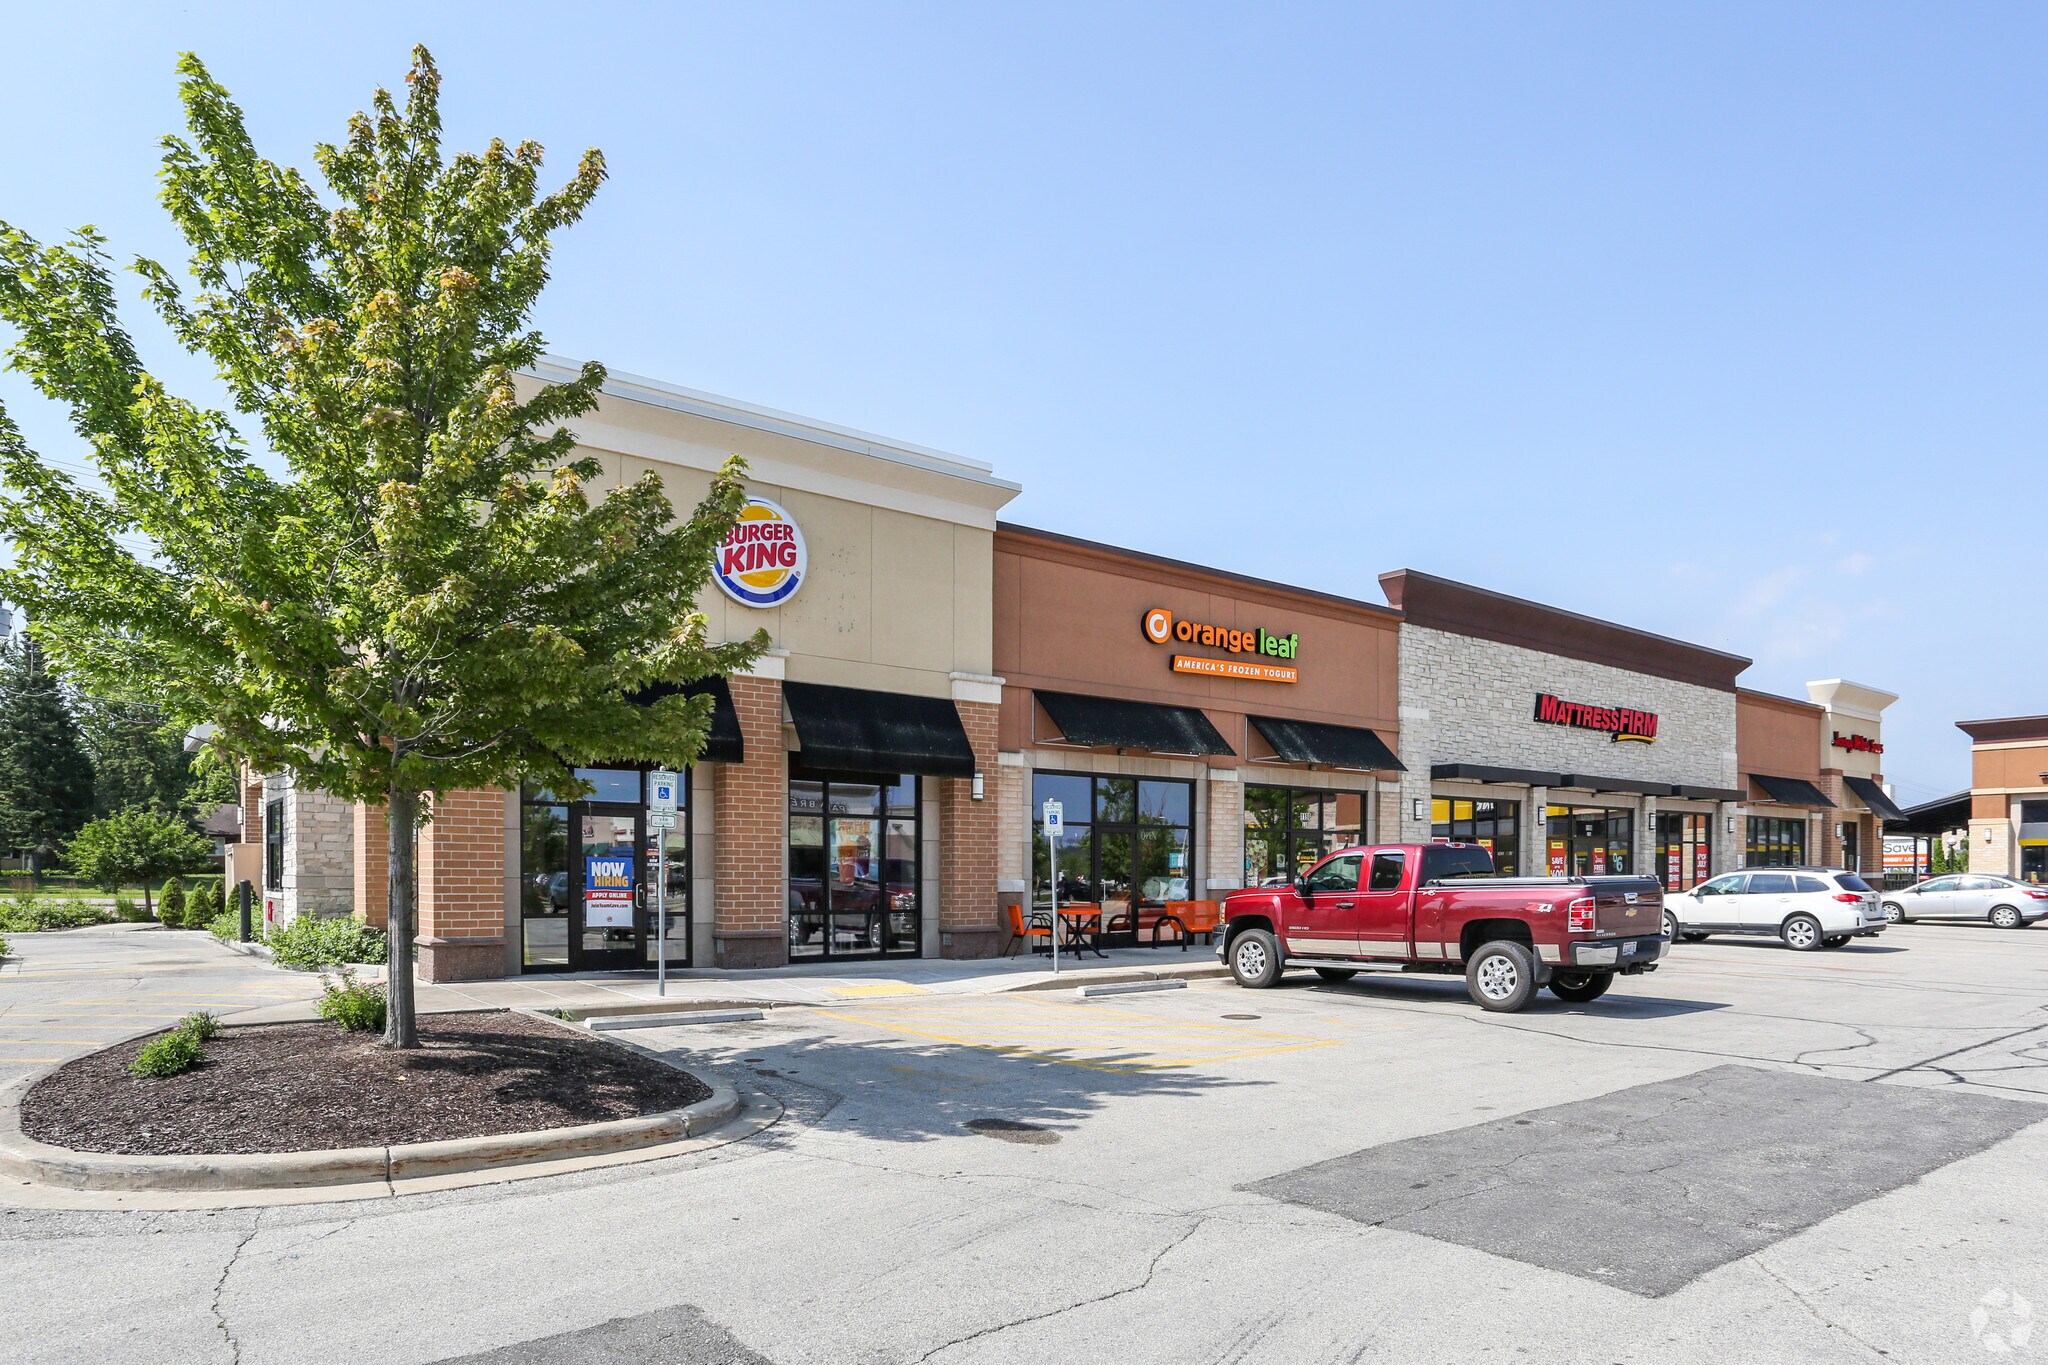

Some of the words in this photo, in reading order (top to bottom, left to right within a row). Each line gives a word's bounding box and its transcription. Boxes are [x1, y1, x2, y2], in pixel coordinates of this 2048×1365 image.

[721, 523, 794, 548] BURGER
[723, 542, 797, 575] KING
[1176, 620, 1255, 653] orange
[1260, 627, 1298, 659] leaf
[1176, 659, 1225, 672] AMERICA'S
[1228, 665, 1261, 676] FROZEN
[654, 780, 674, 788] PARKING
[591, 861, 625, 877] NOW
[594, 875, 629, 887] HIRING
